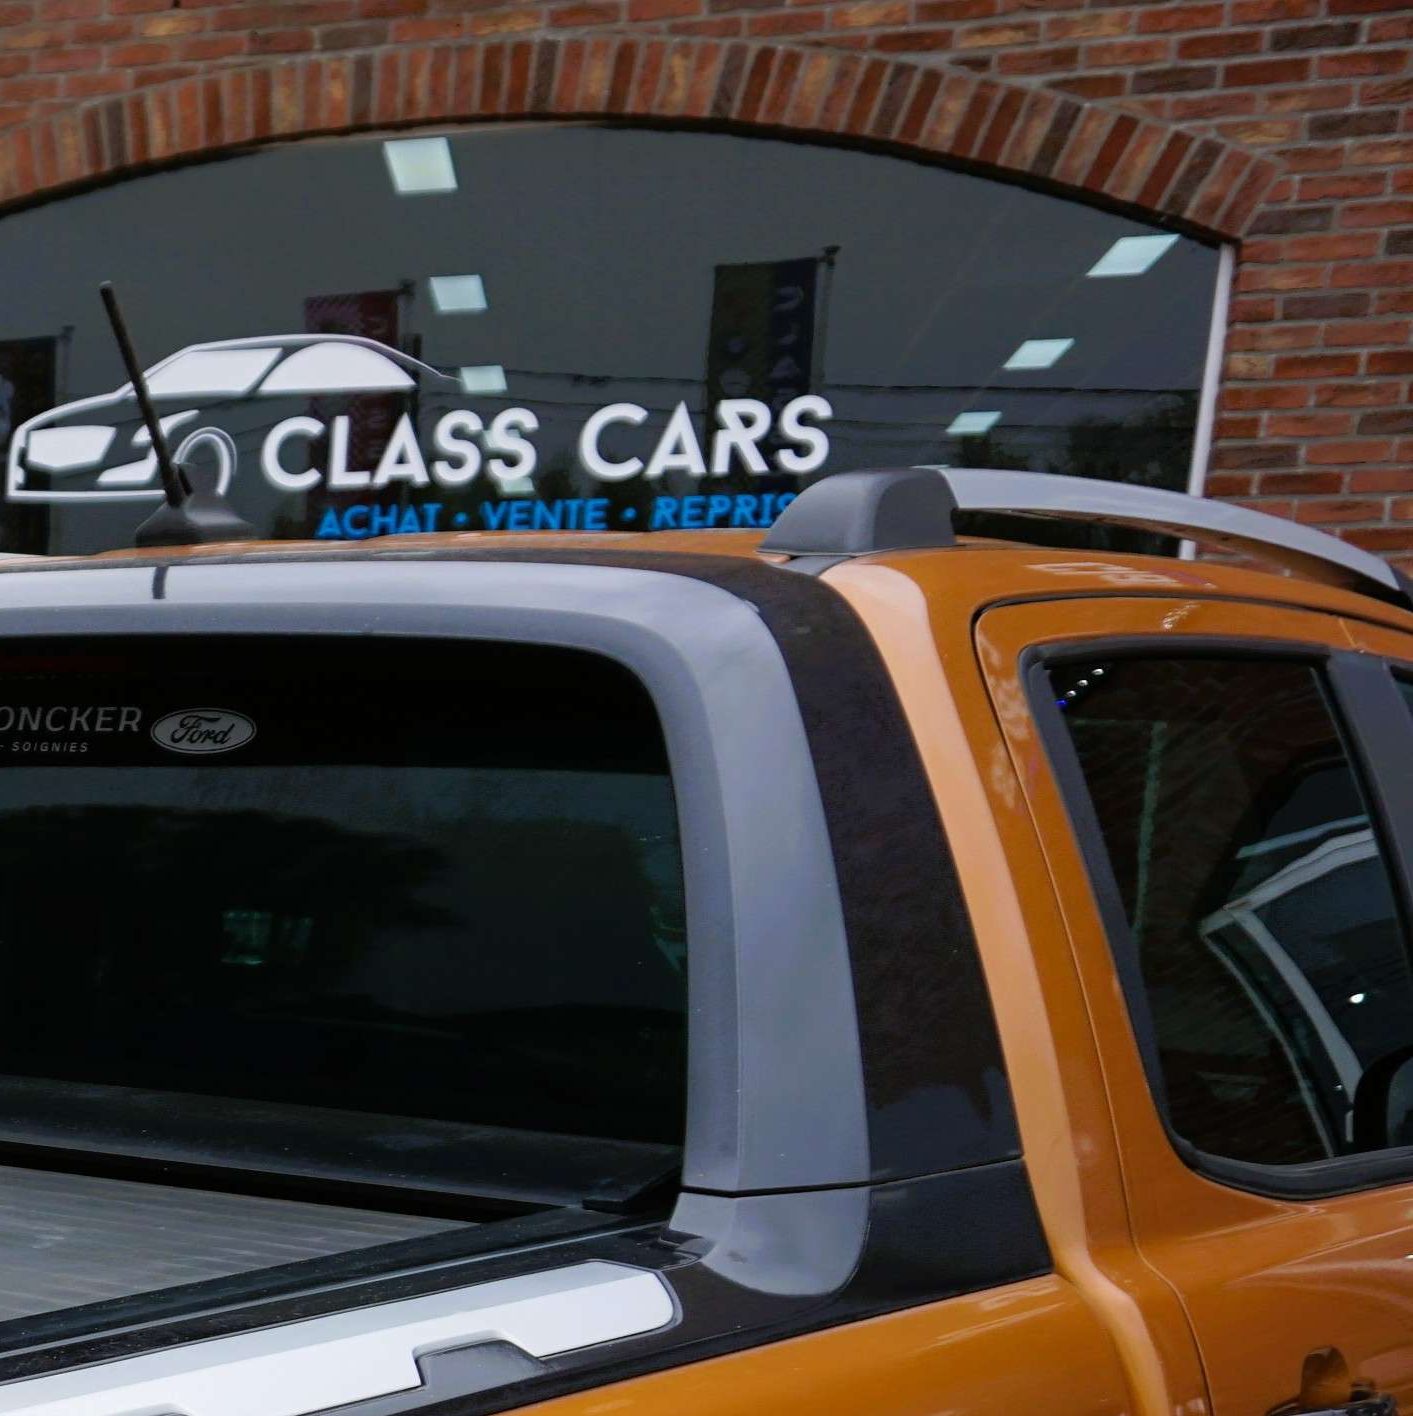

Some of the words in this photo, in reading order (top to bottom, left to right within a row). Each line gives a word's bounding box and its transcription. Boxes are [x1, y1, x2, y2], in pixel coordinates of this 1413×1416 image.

[259, 406, 539, 491] CLASS
[578, 395, 836, 480] CARS
[315, 502, 442, 540] ACHAT
[480, 499, 610, 533] VENTE
[11, 741, 89, 753] SOIGNIES
[170, 713, 235, 747] Ford
